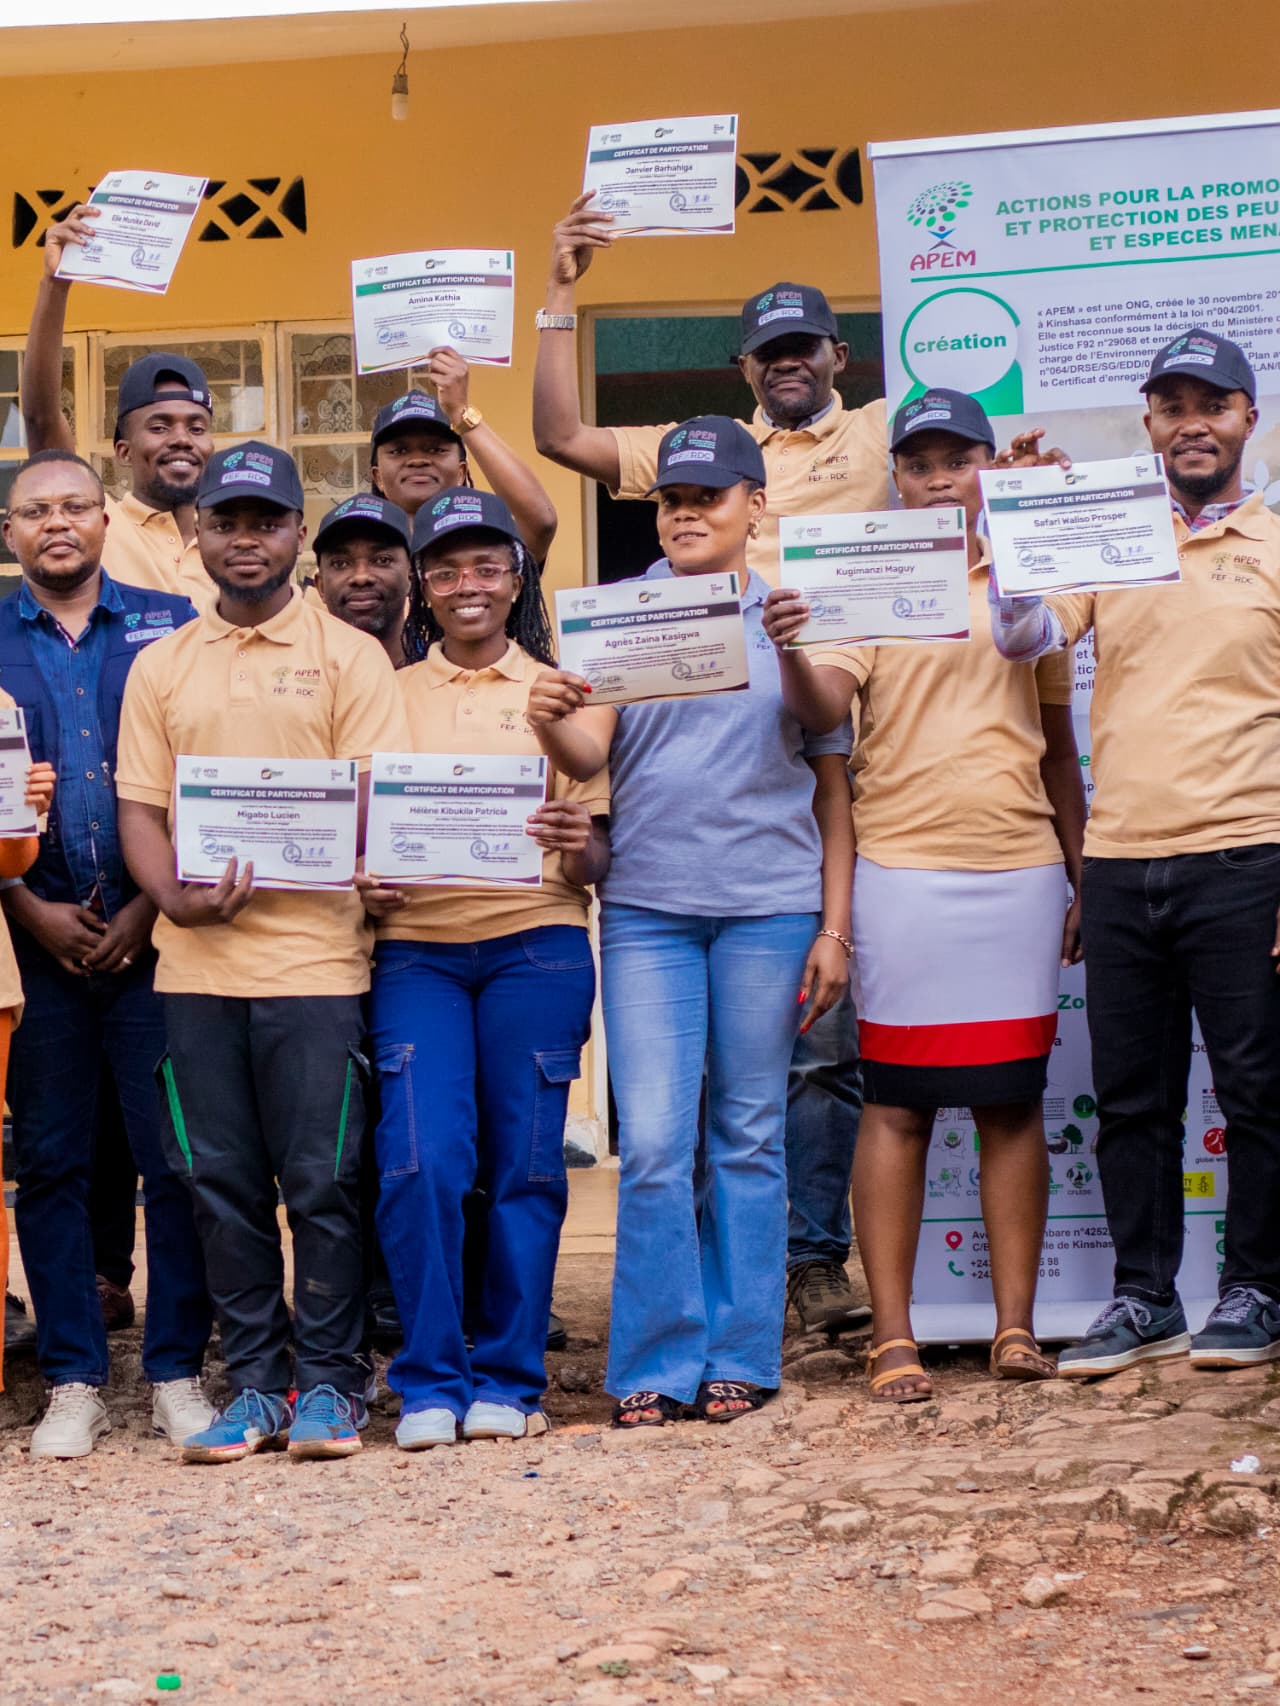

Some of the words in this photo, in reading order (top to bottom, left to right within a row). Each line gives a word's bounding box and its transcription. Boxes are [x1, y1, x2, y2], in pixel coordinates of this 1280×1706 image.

[625, 165, 653, 174] Janvier
[996, 193, 1092, 216] ACTIONS
[1099, 188, 1160, 205] POUR
[1168, 185, 1195, 201] LA
[1006, 220, 1031, 237] ET
[1039, 206, 1179, 234] PROTECTION
[1186, 204, 1229, 221] DES
[1090, 235, 1117, 252] ET
[1124, 227, 1224, 248] ESPECES
[909, 250, 976, 271] APEM
[382, 279, 420, 290] CERTIFICAT
[422, 277, 431, 285] DE
[433, 276, 485, 284] PARTICIPATION
[408, 296, 433, 305] Amina
[435, 293, 461, 301] Kathia
[1045, 306, 1075, 317] APEM
[1087, 304, 1102, 313] est
[1105, 303, 1122, 312] une
[1126, 300, 1153, 310] ONG,
[1155, 298, 1183, 308] créée
[1199, 296, 1210, 305] 30
[1213, 292, 1263, 304] novembre
[1046, 316, 1092, 328] Kinshasa
[1095, 310, 1168, 326] conformément
[1192, 308, 1204, 317] loi
[1038, 331, 1056, 341] Elle
[1059, 329, 1074, 339] est
[1077, 326, 1123, 337] reconnue
[1126, 325, 1151, 333] sous
[1166, 319, 1209, 331] décision
[1212, 317, 1224, 327] du
[1227, 315, 1273, 326] Ministère
[1227, 327, 1273, 337] Ministère
[913, 333, 1007, 354] création
[1038, 341, 1073, 353] Justice
[1077, 339, 1095, 349] F92
[1039, 353, 1073, 365] charge
[1076, 351, 1087, 361] de
[1248, 350, 1270, 360] Plan
[1051, 374, 1096, 386] Certificat
[1019, 497, 1062, 507] CERTIFICAT
[1075, 489, 1134, 502] PARTICIPATION
[1034, 517, 1061, 527] Safari
[1092, 511, 1127, 523] Prosper
[815, 546, 860, 555] CERTIFICAT
[862, 545, 871, 553] DE
[873, 542, 933, 551] PARTICIPATION
[836, 566, 883, 577] Kugimanzi
[885, 565, 915, 575] Maguy
[591, 616, 635, 627] CERTIFICAT
[636, 615, 646, 623] DE
[647, 608, 708, 621] PARTICIPATION
[635, 635, 660, 645] Zaina
[662, 631, 700, 643] Kasigwa
[211, 789, 255, 797] CERTIFICAT
[256, 790, 267, 798] DE
[268, 790, 326, 799] PARTICIPATION
[404, 785, 446, 794] CERTIFICAT
[448, 786, 457, 794] DE
[237, 810, 269, 821] Migabo
[271, 811, 300, 819] Lucien
[475, 807, 508, 815] Patricia
[1057, 1240, 1070, 1249] de
[1049, 1269, 1060, 1277] 06
